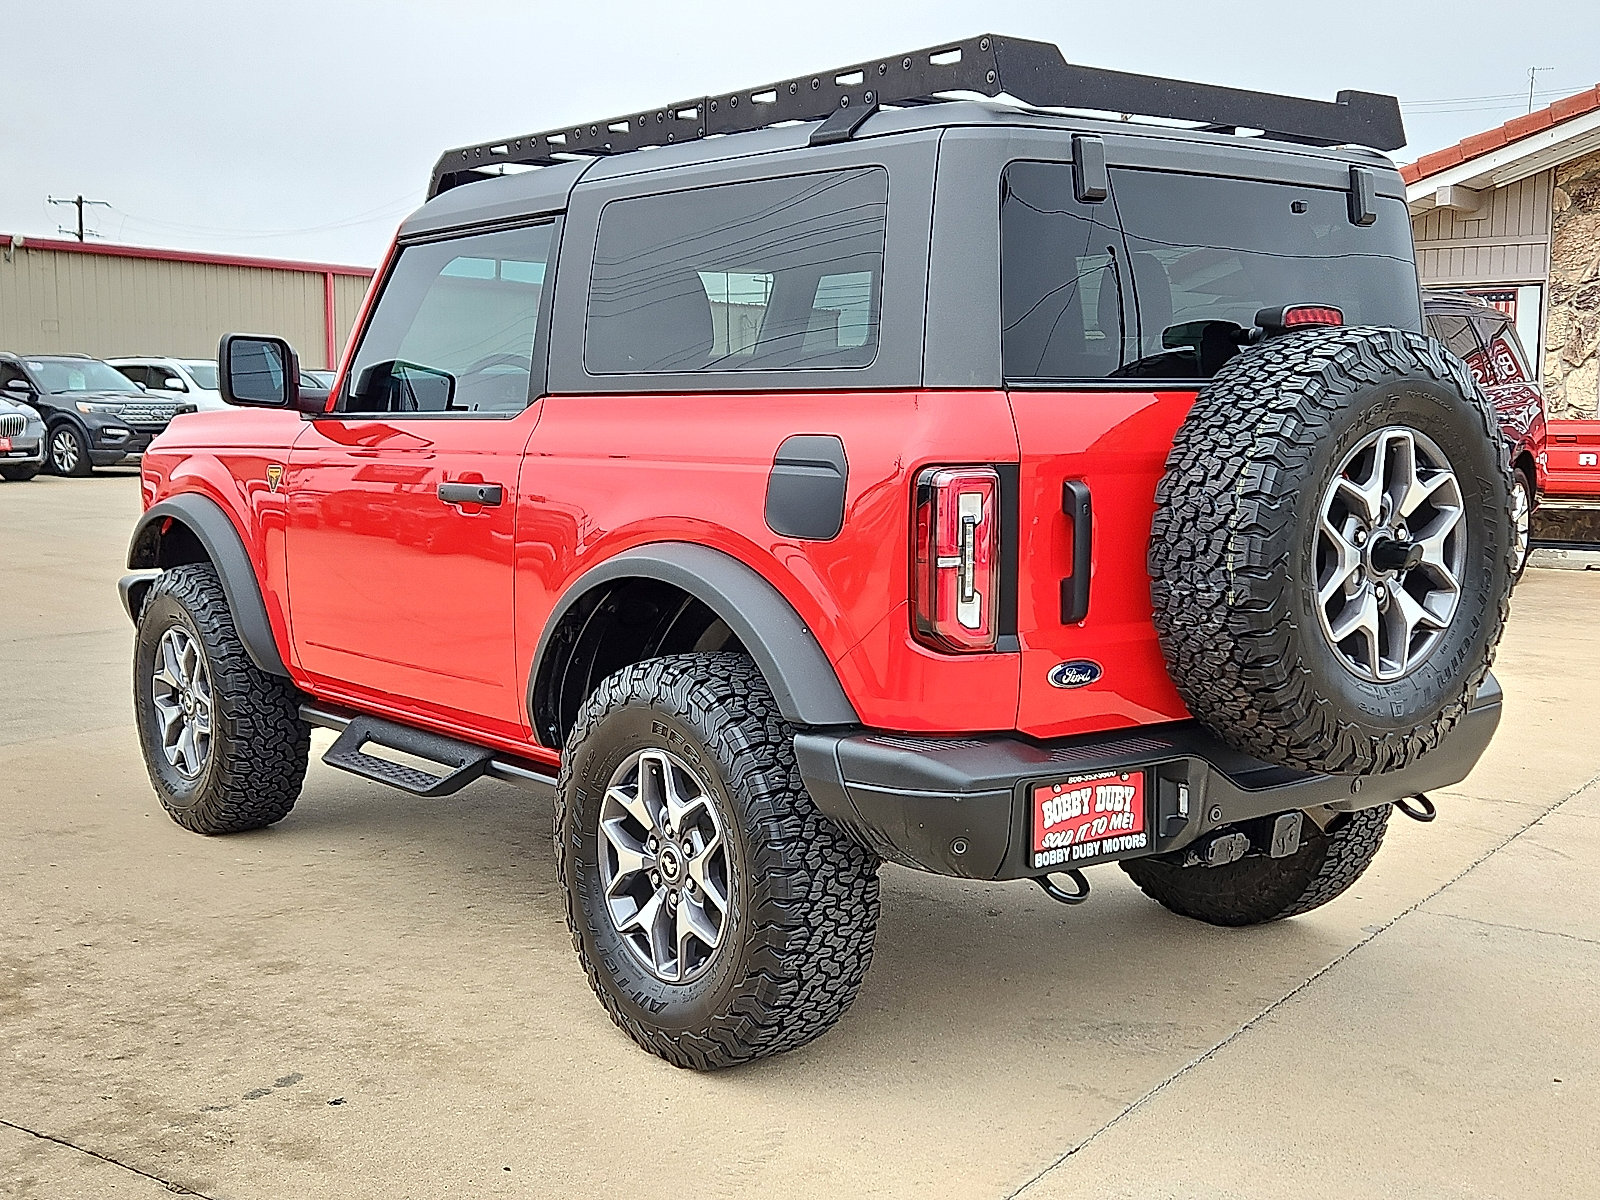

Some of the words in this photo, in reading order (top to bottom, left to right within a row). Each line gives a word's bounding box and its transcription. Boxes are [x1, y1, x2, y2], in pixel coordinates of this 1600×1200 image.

[1062, 668, 1091, 684] Ford
[1041, 787, 1093, 829] BOBBY
[1094, 785, 1136, 813] DUBY
[1042, 829, 1075, 849] SOLD
[1075, 822, 1091, 843] IT
[1090, 816, 1108, 837] TO
[1108, 811, 1135, 831] ME!
[1034, 848, 1071, 869] BOBBY
[1072, 841, 1101, 860] DUBY
[1102, 833, 1147, 854] MOTORS
